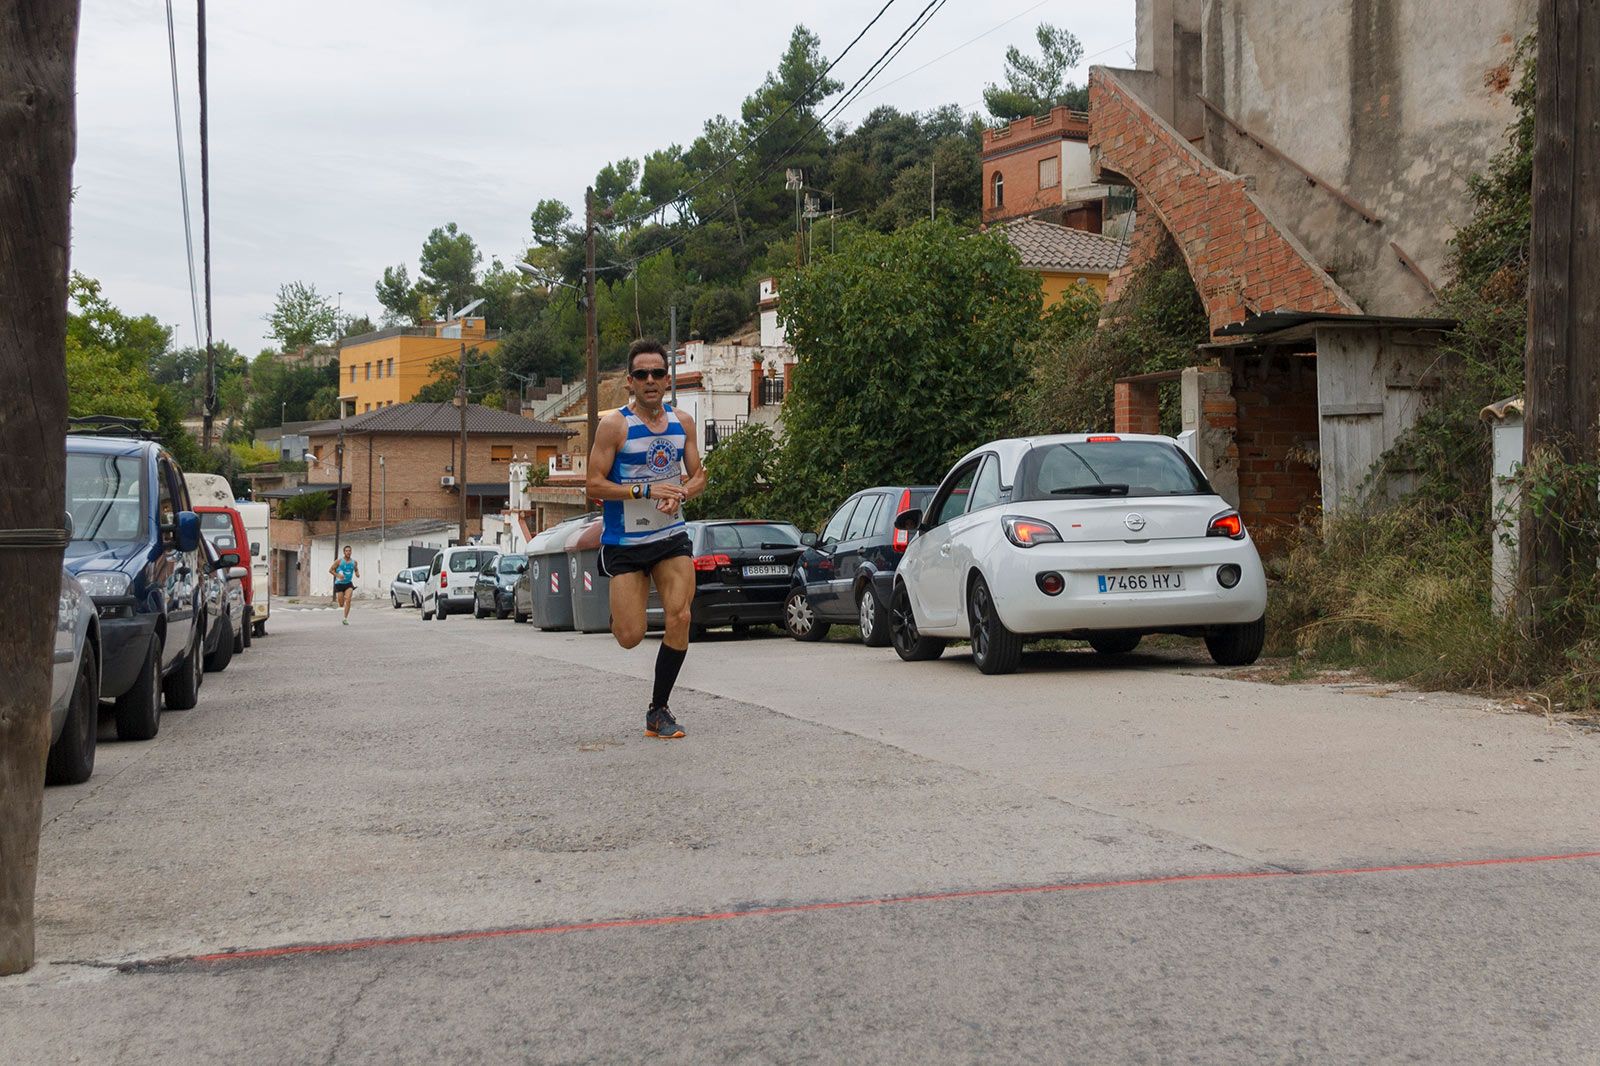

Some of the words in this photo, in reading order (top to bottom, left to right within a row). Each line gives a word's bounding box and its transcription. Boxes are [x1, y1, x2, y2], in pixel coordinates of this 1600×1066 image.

[748, 566, 769, 575] 6869
[771, 565, 786, 574] HJS
[1107, 575, 1148, 591] 7466
[1152, 574, 1181, 589] HYJ
